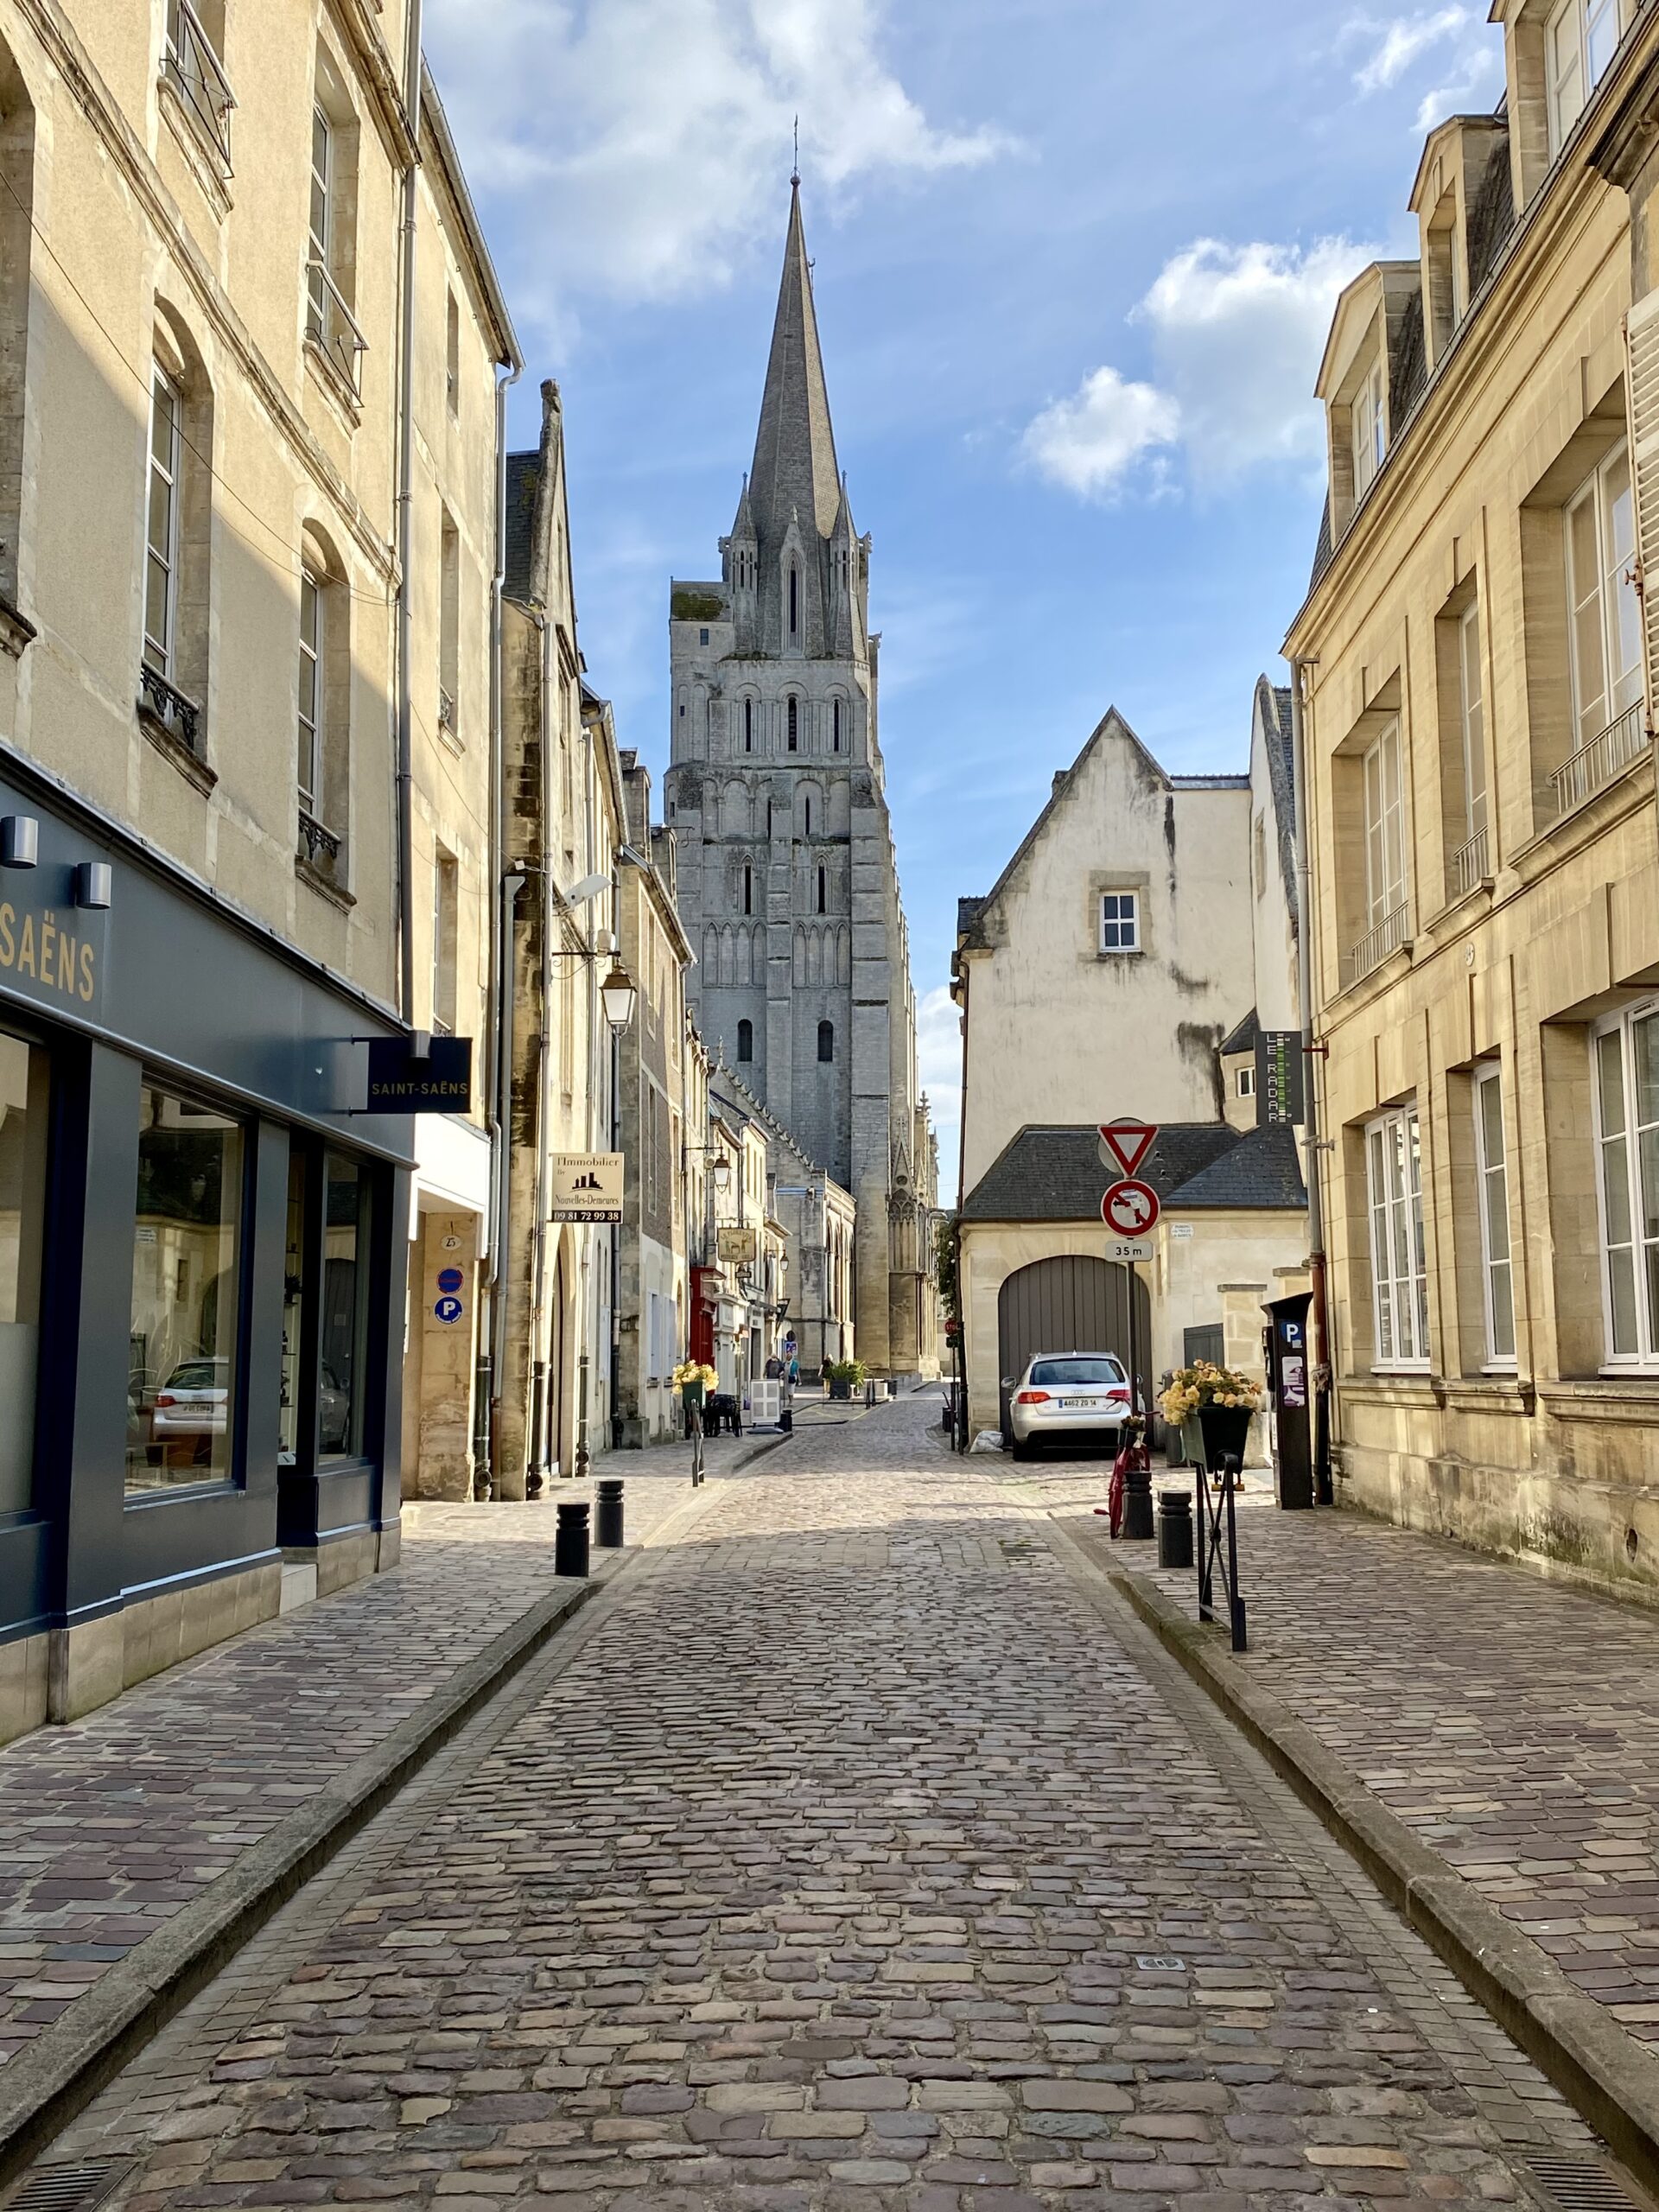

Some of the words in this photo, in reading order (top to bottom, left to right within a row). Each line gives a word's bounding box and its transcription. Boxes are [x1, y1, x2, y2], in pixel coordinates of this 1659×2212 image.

[0, 902, 94, 1002] SAËNS
[1267, 1033, 1276, 1055] LE
[372, 1080, 468, 1095] SAINT-SAËNS
[1268, 1064, 1279, 1122] RADAR
[554, 1211, 566, 1220] 09
[568, 1211, 577, 1220] 81
[581, 1211, 592, 1220] 72
[594, 1211, 605, 1220] 99
[607, 1211, 619, 1220] 38
[1116, 1246, 1129, 1255] 35
[443, 1300, 456, 1316] P
[1287, 1324, 1299, 1342] P
